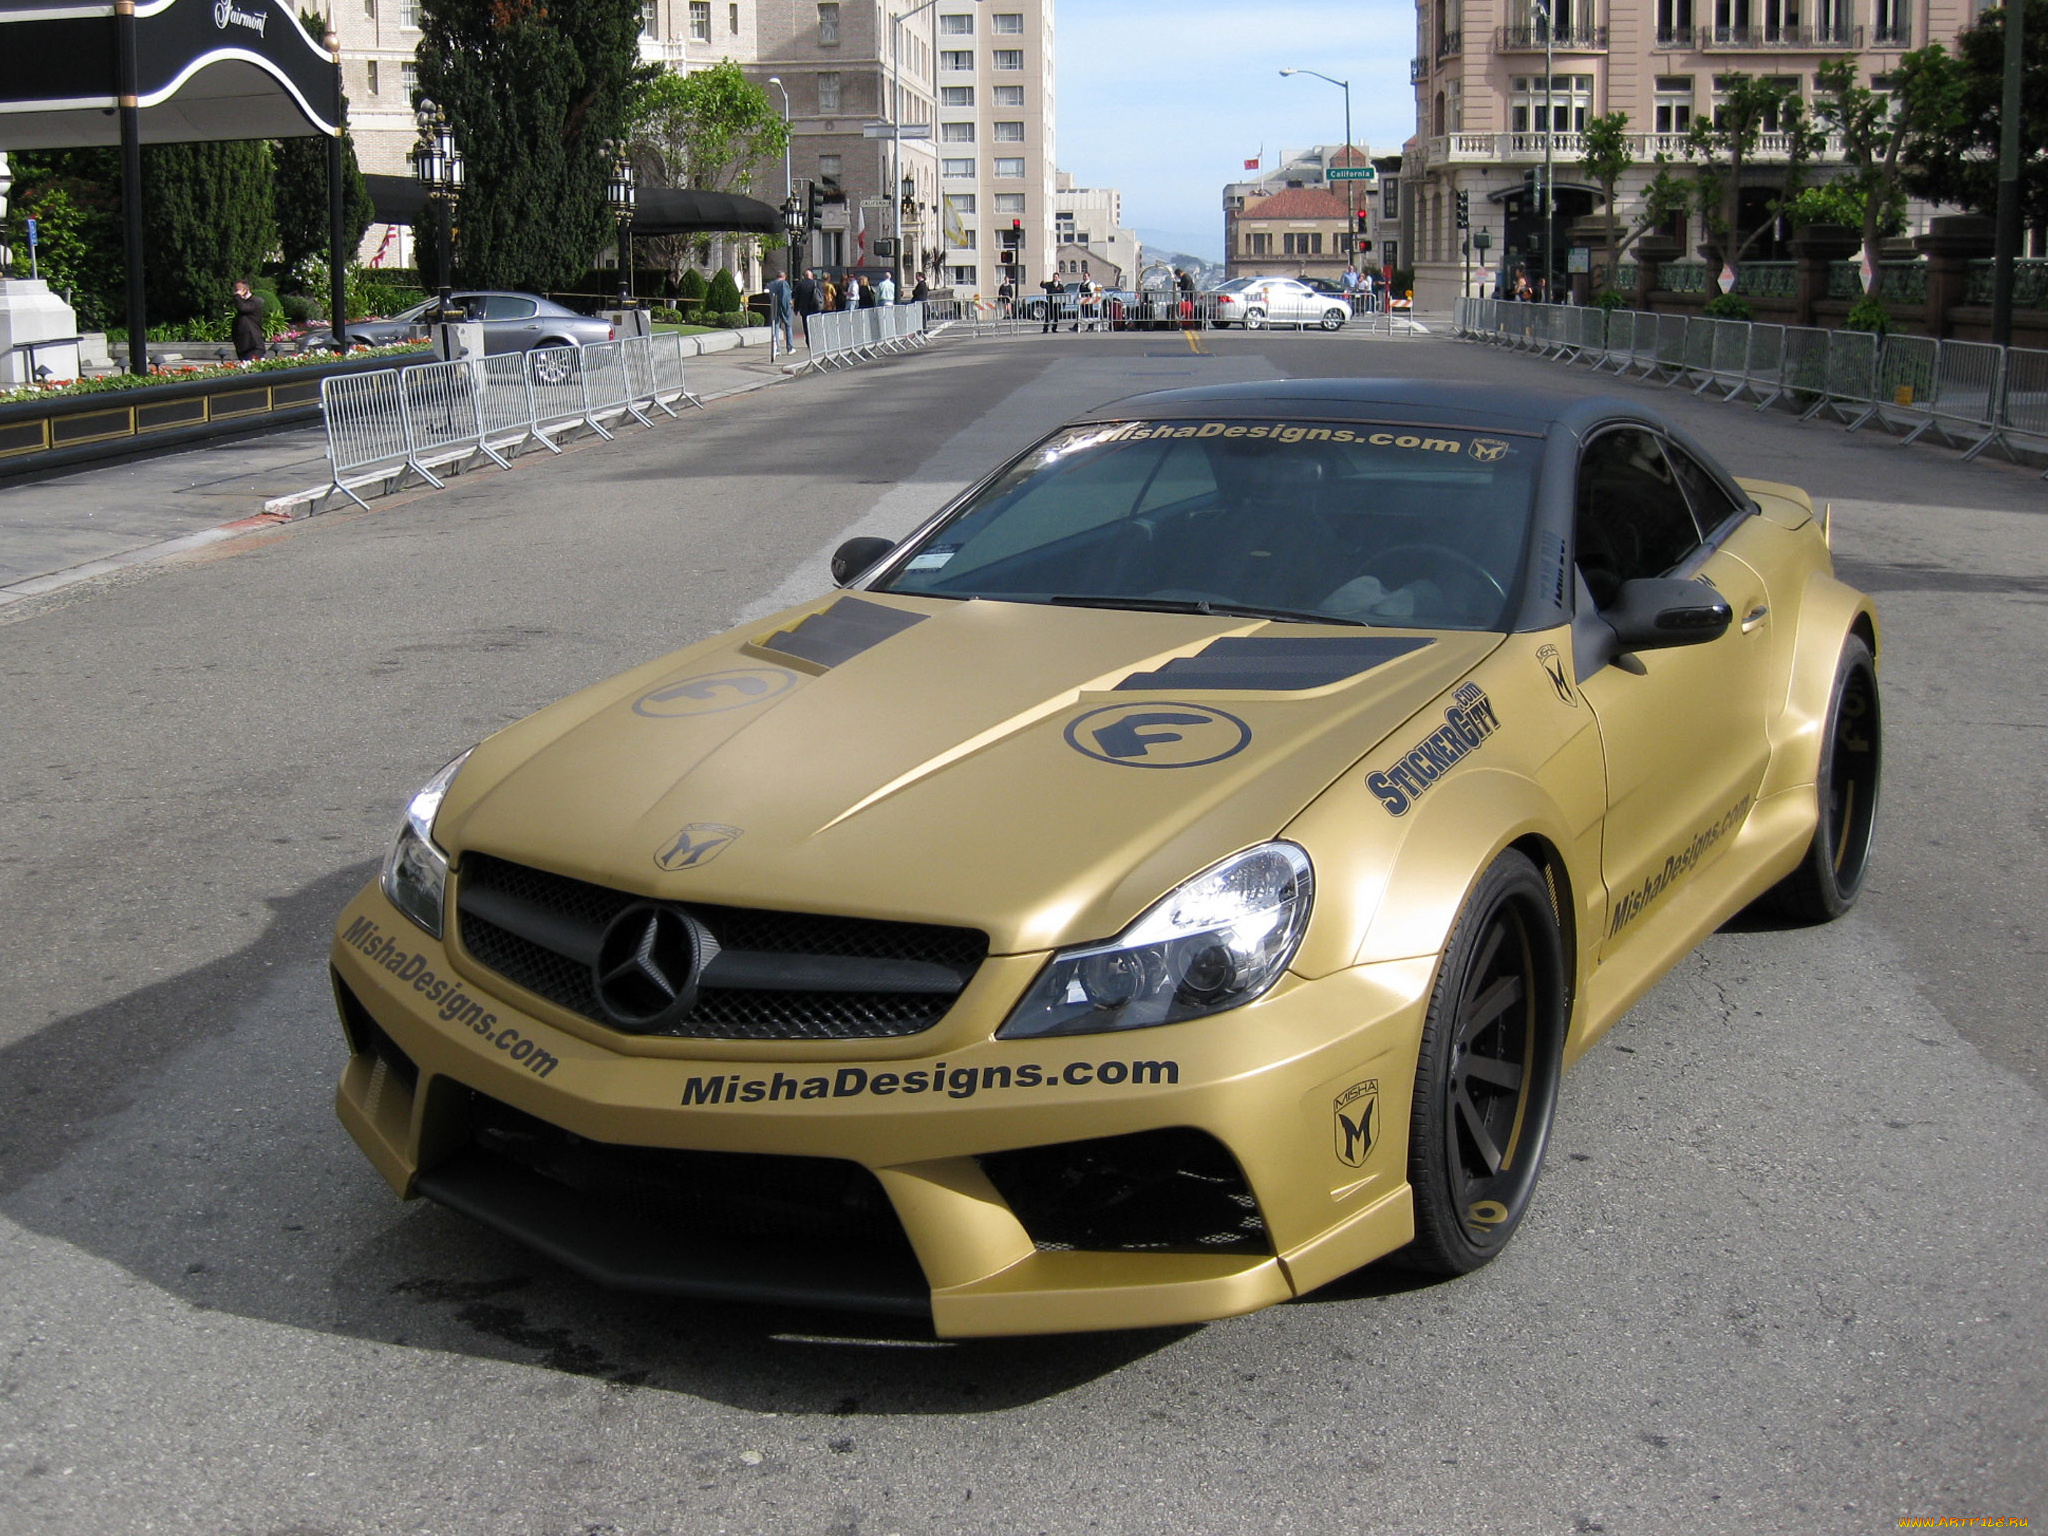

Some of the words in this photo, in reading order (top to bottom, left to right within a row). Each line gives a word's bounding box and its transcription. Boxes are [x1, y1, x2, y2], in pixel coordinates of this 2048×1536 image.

[215, 0, 268, 38] Fairmont
[1330, 170, 1370, 178] California
[1608, 794, 1750, 940] MishaDesigns.com
[341, 916, 559, 1078] MishaDesigns.com
[680, 1059, 1179, 1106] MishaDesigns.com
[1335, 1081, 1376, 1110] MISHA
